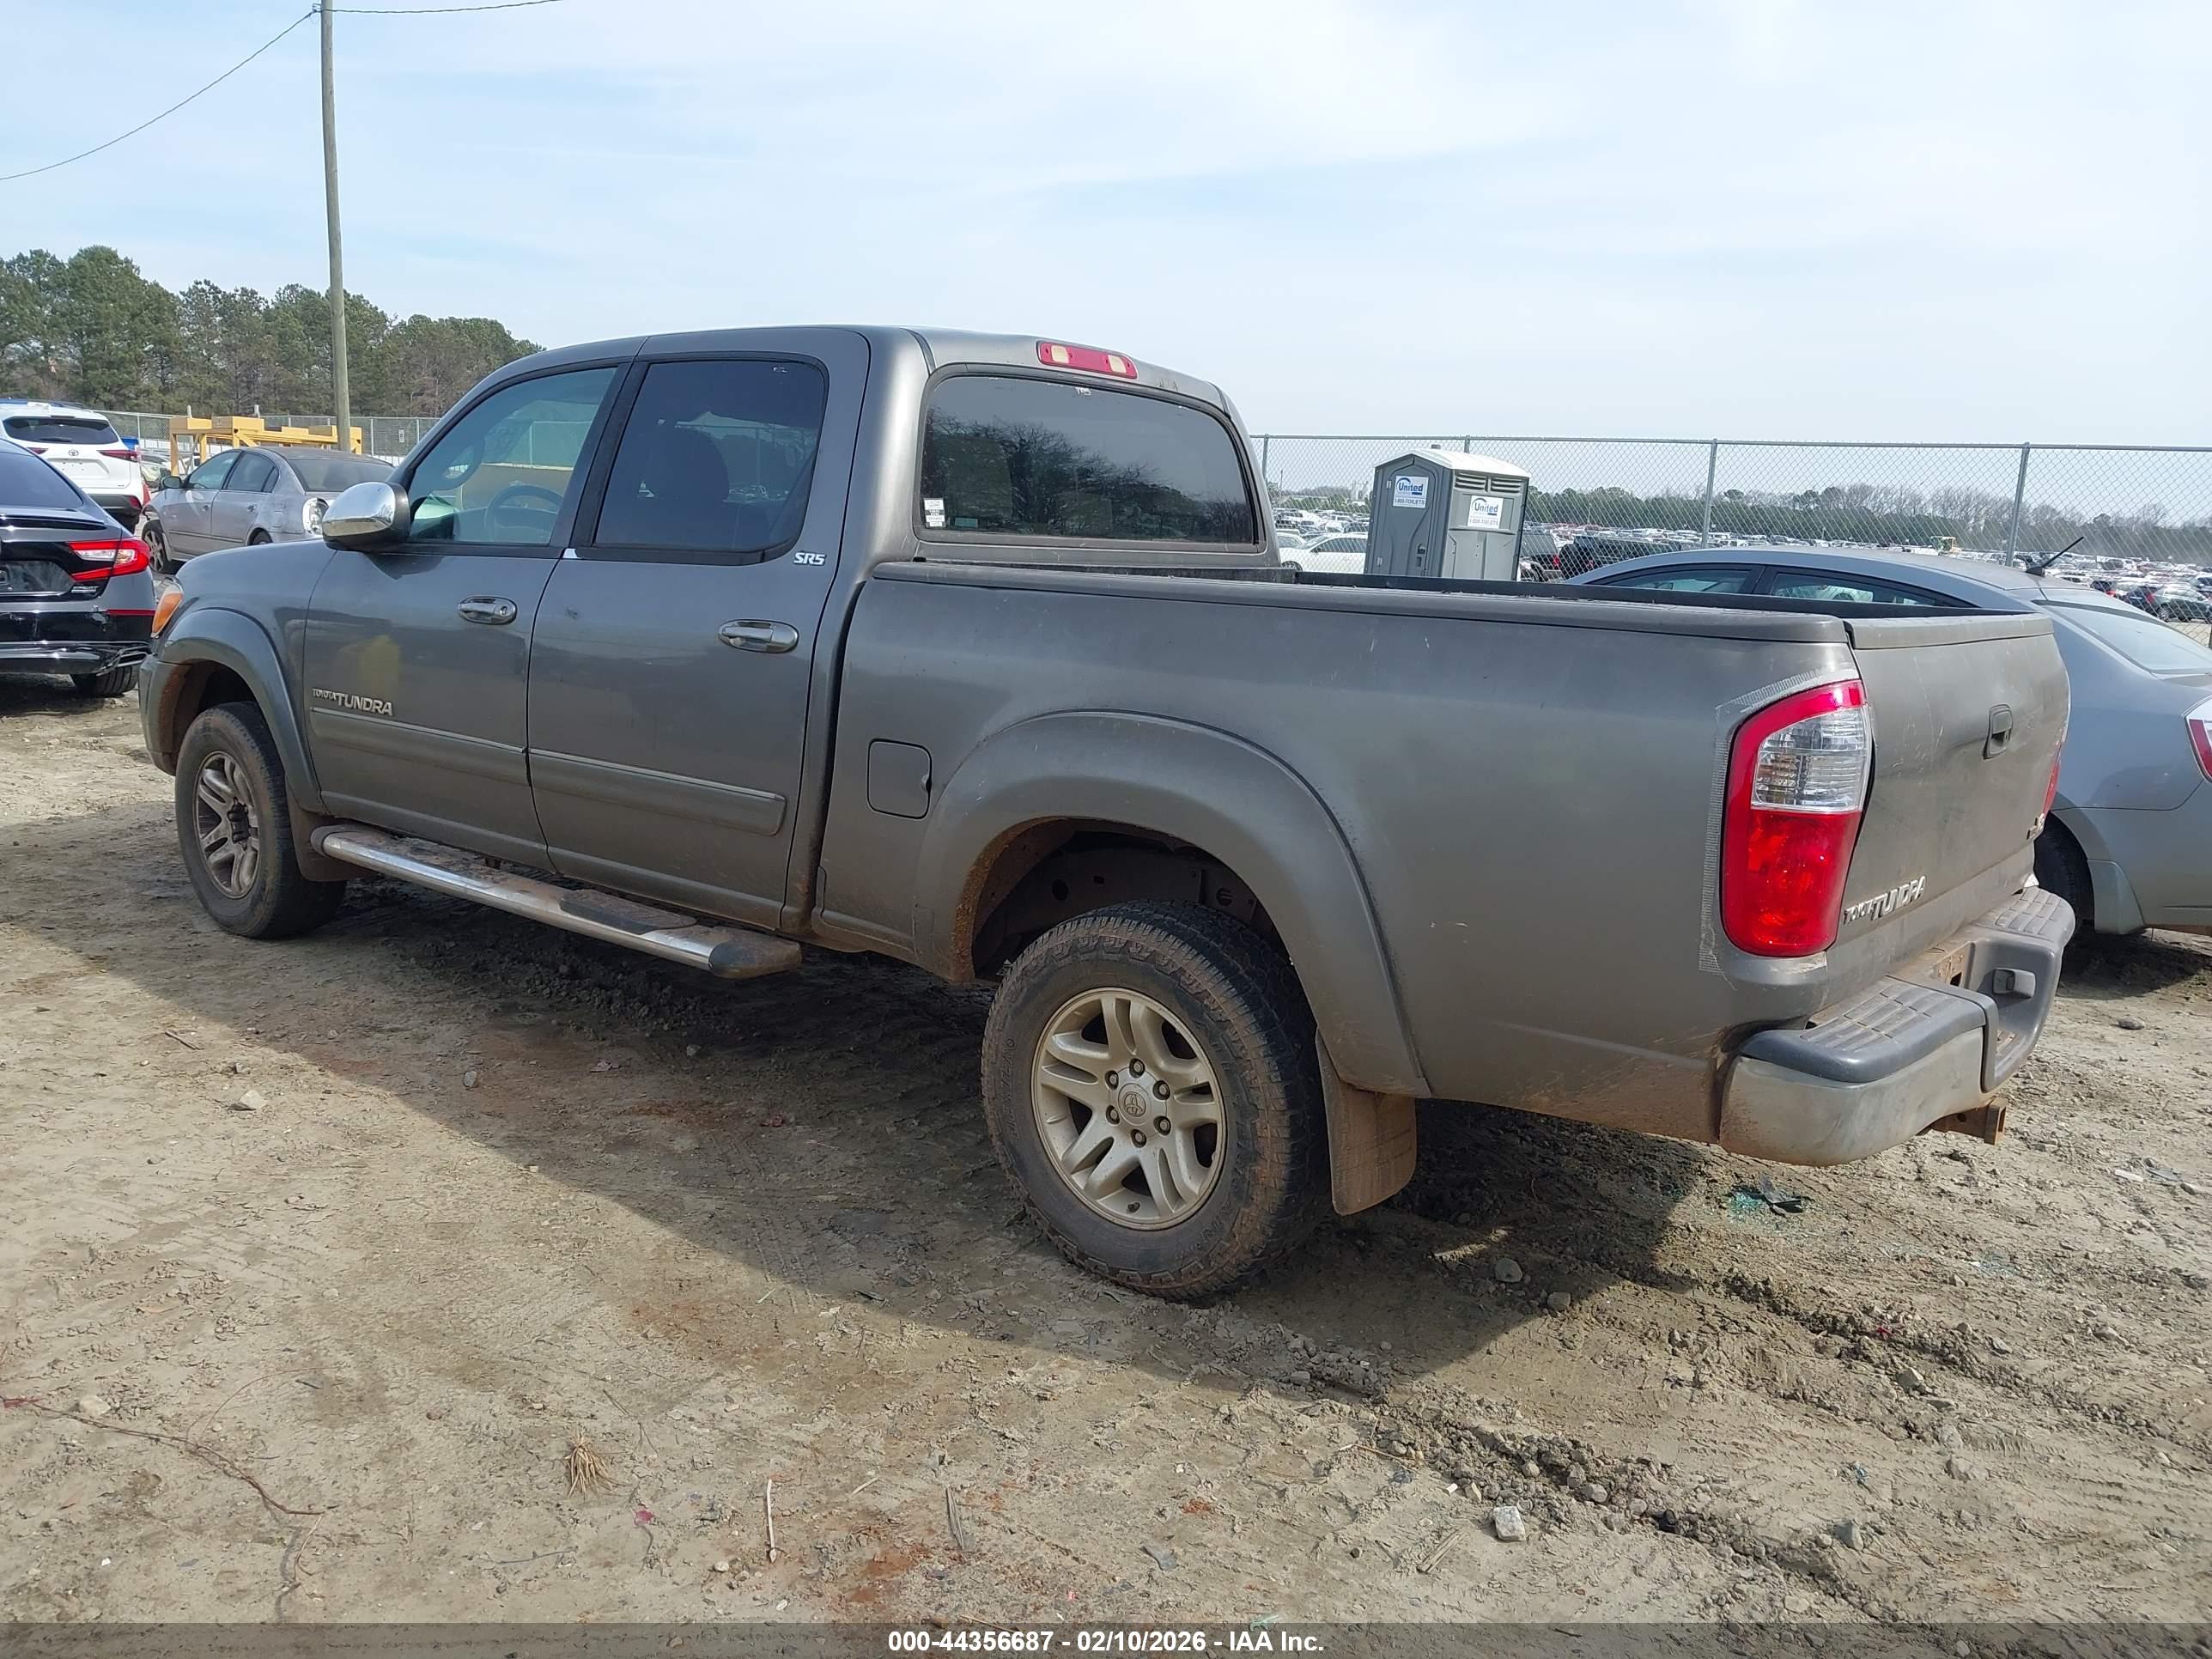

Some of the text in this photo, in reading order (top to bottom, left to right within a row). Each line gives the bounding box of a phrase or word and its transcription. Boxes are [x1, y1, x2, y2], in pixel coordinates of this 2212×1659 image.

[1399, 482, 1424, 492] United
[1474, 502, 1499, 513] United
[793, 552, 826, 565] SR5
[312, 688, 393, 716] TOYOTA TUNDRA
[1870, 875, 1926, 921] TUNDRA
